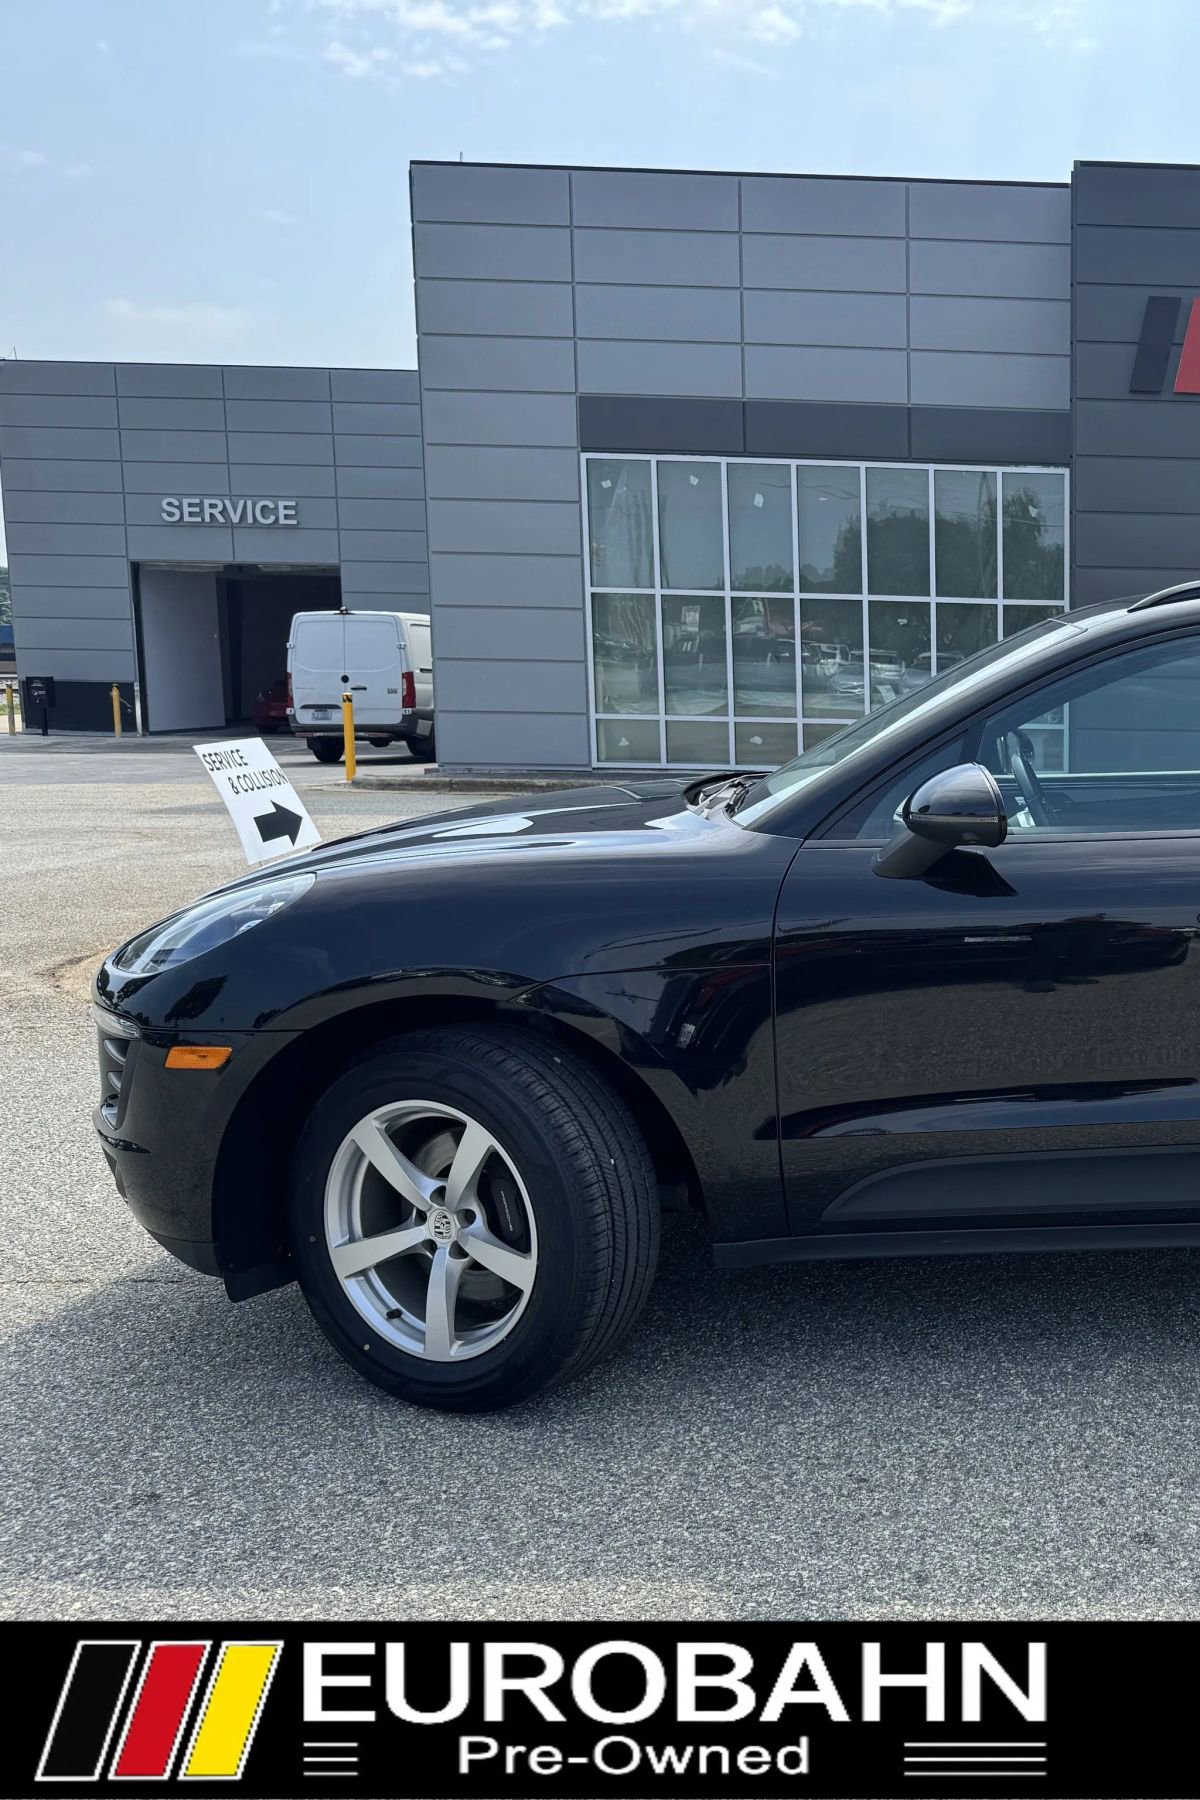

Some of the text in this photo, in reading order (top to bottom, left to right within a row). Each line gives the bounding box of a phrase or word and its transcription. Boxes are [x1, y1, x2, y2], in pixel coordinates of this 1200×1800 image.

[160, 497, 298, 526] SERVICE
[202, 748, 249, 772] SERVICE
[227, 767, 289, 795] & COLLISION
